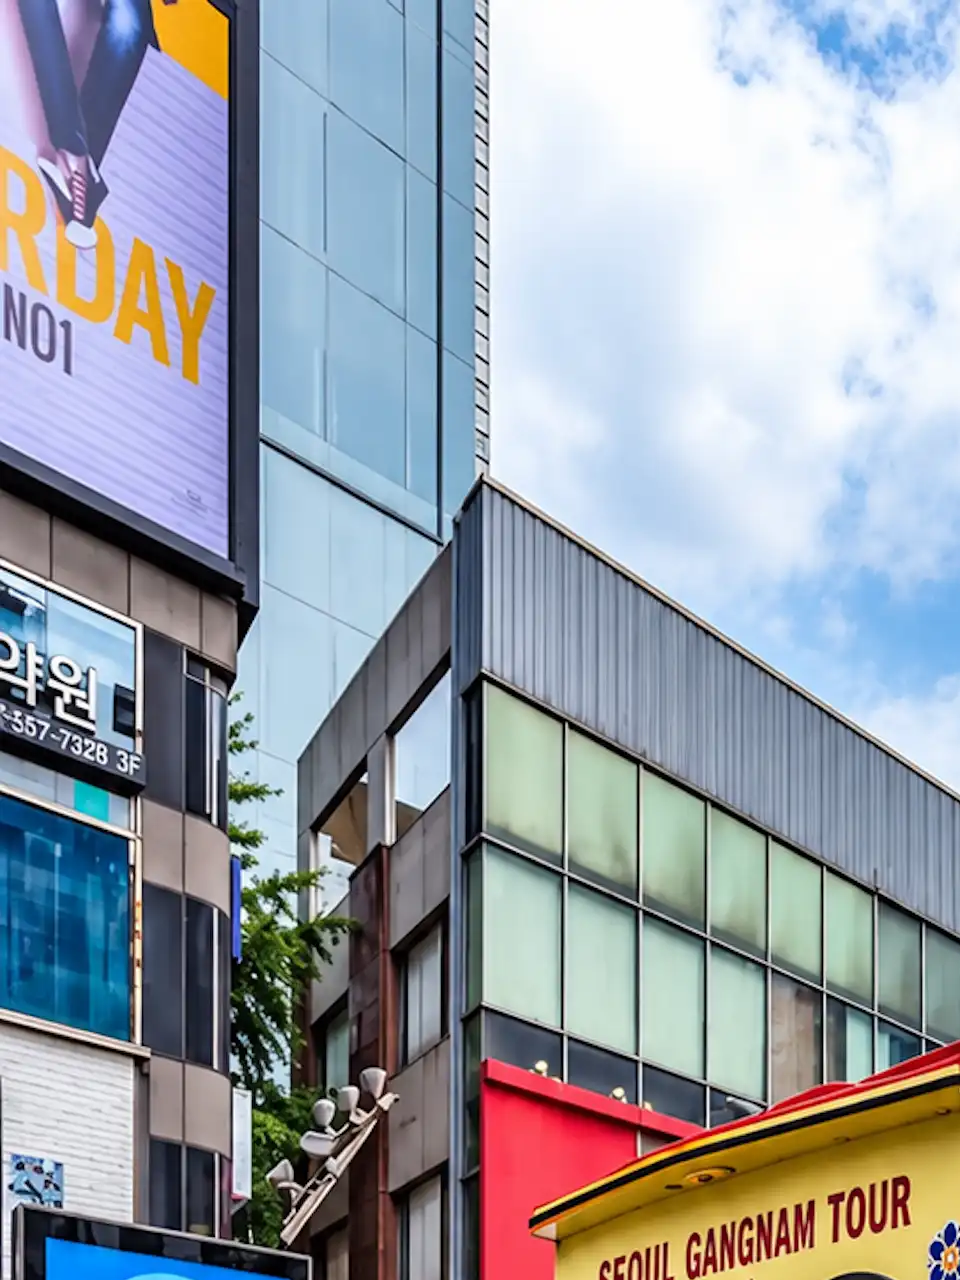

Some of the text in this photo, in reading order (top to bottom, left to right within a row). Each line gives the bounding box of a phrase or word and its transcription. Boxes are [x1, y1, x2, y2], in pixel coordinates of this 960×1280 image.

[116, 750, 141, 776] 3F
[686, 1200, 816, 1280] GANGNAM
[827, 1175, 911, 1244] TOUR
